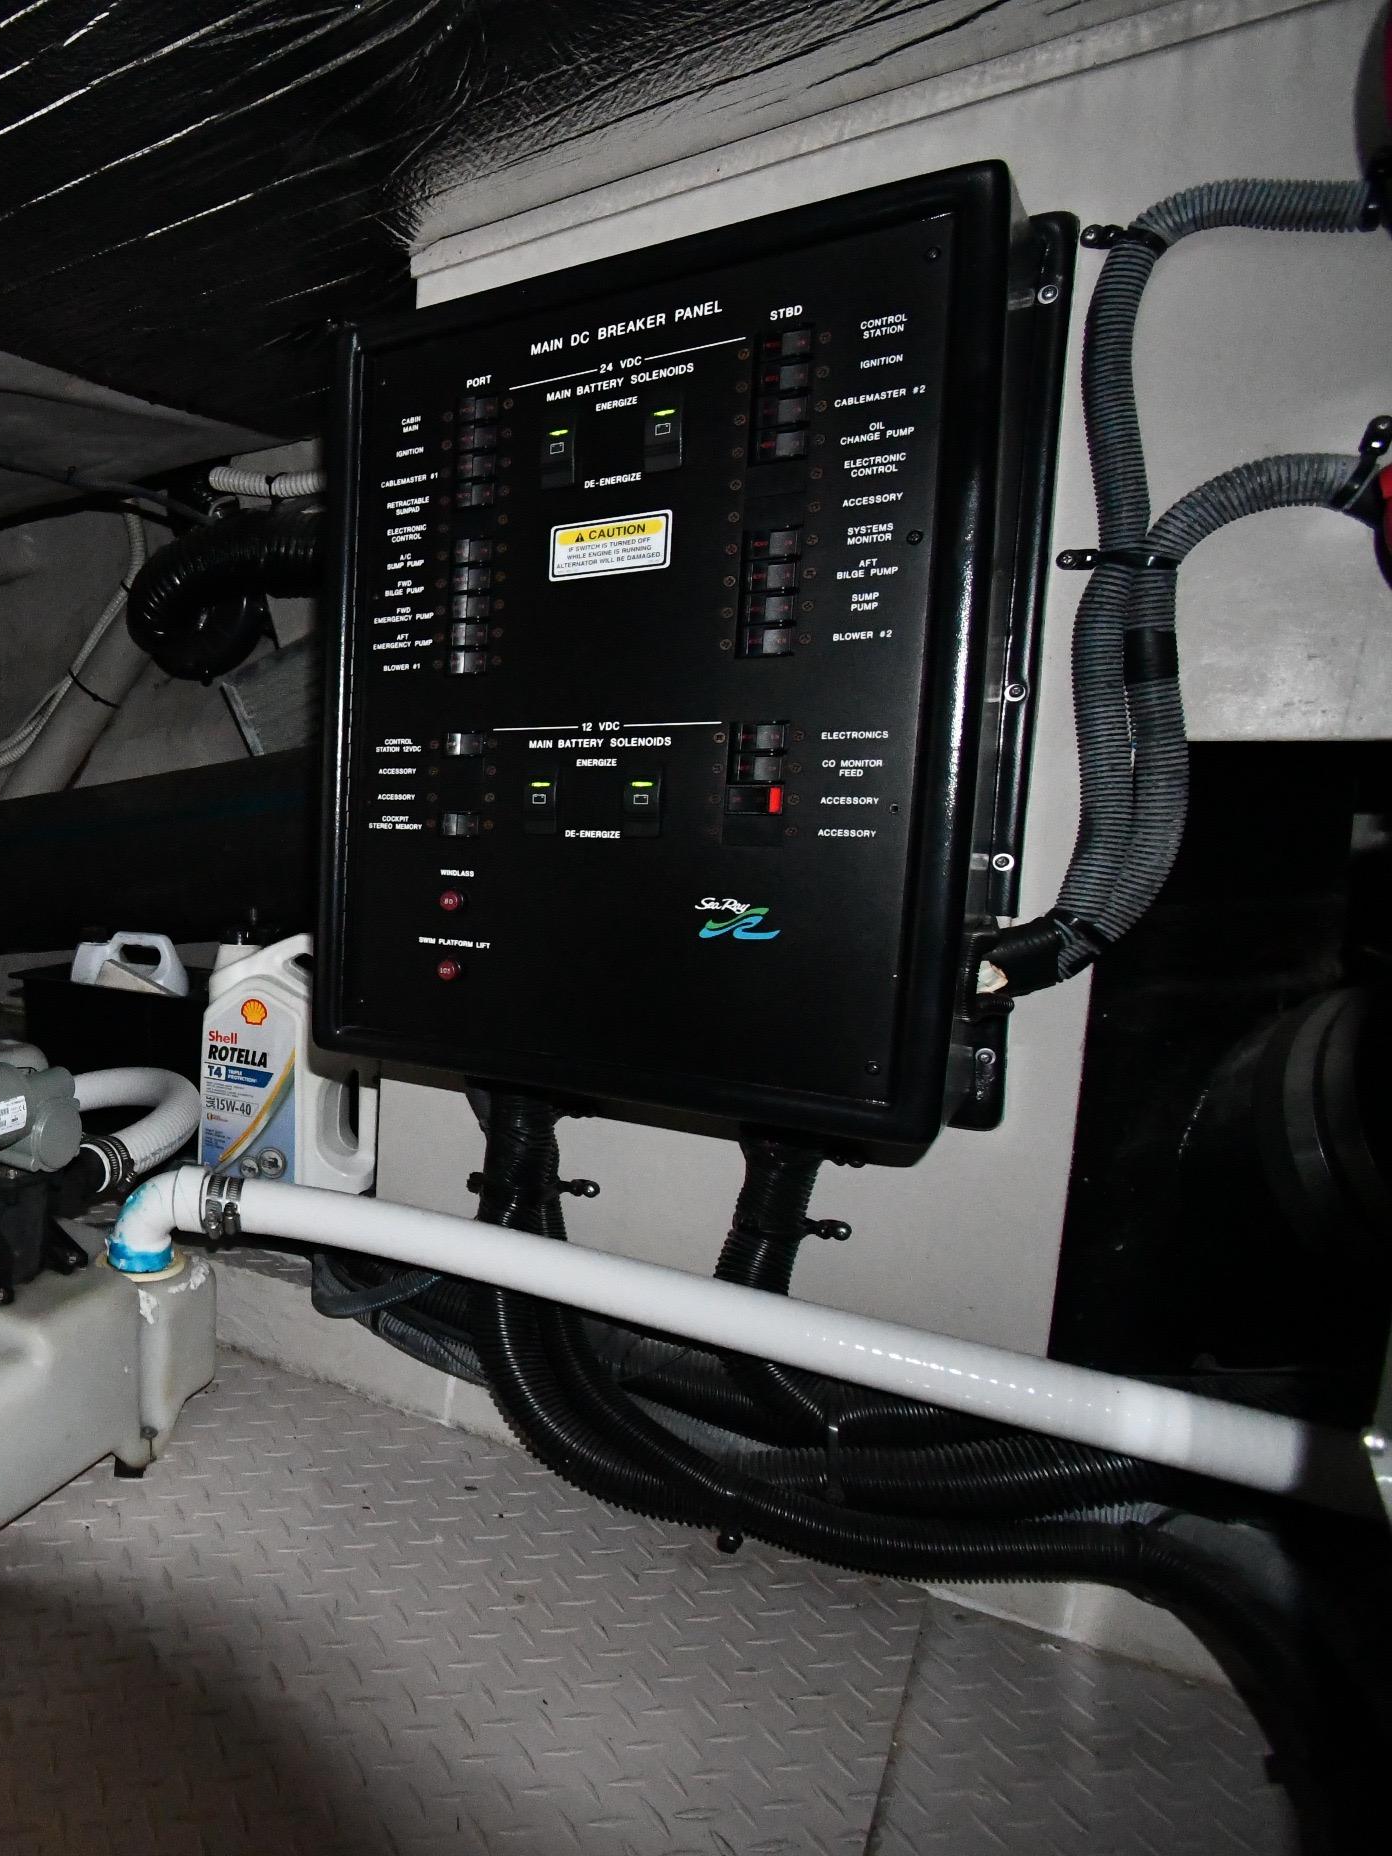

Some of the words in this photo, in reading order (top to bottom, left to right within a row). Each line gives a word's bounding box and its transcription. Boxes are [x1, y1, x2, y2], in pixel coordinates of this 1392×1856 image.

[770, 305, 802, 320] STBD
[531, 338, 563, 355] MAIN
[571, 331, 589, 346] DC
[598, 313, 665, 340] BREAKER
[675, 301, 722, 322] PANEL
[861, 314, 907, 330] CONTROL
[863, 324, 904, 339] STATION
[600, 363, 613, 373] 24
[620, 356, 641, 368] VDC
[861, 354, 903, 369] IGNITION
[467, 375, 491, 388] PORT
[547, 389, 571, 402] MAIN
[576, 377, 624, 395] BATTERY
[630, 362, 694, 384] SOLENOIDS
[834, 388, 906, 407] CABLEMASTER
[913, 385, 925, 394] #2
[596, 396, 638, 411] ENERGIZE
[402, 416, 421, 425] CABIN
[869, 422, 885, 431] OIL
[402, 424, 418, 433] MAIN
[840, 431, 880, 445] CHANGE
[886, 427, 914, 438] PUMP
[396, 447, 424, 457] IGNITION
[844, 453, 906, 469] ELECTRONIC
[851, 464, 898, 477] CONTROL
[381, 474, 426, 488] CABLEMASTER
[584, 472, 641, 488] DE-ENERGIZE
[387, 496, 429, 509] RETRACTABLE
[843, 492, 903, 507] ACCESSORY
[396, 505, 421, 515] SUNPAD
[387, 524, 426, 536] ELECTRONIC
[588, 523, 646, 541] CAUTION
[848, 523, 893, 536] SYSTEMS
[391, 532, 421, 542] CONTROL
[610, 539, 636, 547] TURNED
[847, 533, 892, 545] MONITOR
[621, 545, 652, 553] RUNNING
[400, 553, 411, 562] A/C
[556, 557, 597, 569] ALTERNATOR
[627, 551, 660, 561] DAMAGED
[859, 558, 877, 567] AFT
[387, 561, 403, 570] SUMP
[406, 559, 424, 567] PUMP
[837, 568, 867, 579] BILGE
[870, 566, 898, 576] PUMP
[397, 580, 412, 588] FWD
[385, 588, 402, 597] BILGE
[406, 586, 424, 594] PUMP
[852, 592, 879, 602] SUMP
[397, 607, 411, 615] FWD
[851, 602, 878, 611] PUMP
[374, 613, 412, 624] EMERGENCY
[416, 612, 434, 620] PUMP
[833, 631, 873, 641] BLOWER
[373, 640, 411, 650] EMERGENCY
[582, 722, 592, 731] 12
[599, 722, 619, 731] VDC
[821, 731, 888, 739] ELECTRONICS
[529, 740, 554, 748] MAIN
[558, 739, 604, 748] BATTERY
[610, 737, 671, 747] SOLENOIDS
[841, 759, 883, 767] MONITOR
[839, 769, 863, 777] FEED
[565, 830, 620, 838] DE-ENERGIZE
[818, 829, 876, 837] ACCESSORY
[695, 897, 723, 910] Sea
[722, 899, 751, 914] Ray
[439, 938, 473, 947] PLATFORM
[208, 1030, 238, 1044] Shell
[208, 1044, 268, 1068] ROTELLA
[208, 1066, 222, 1078] T4
[216, 1097, 251, 1116] 15W-40
